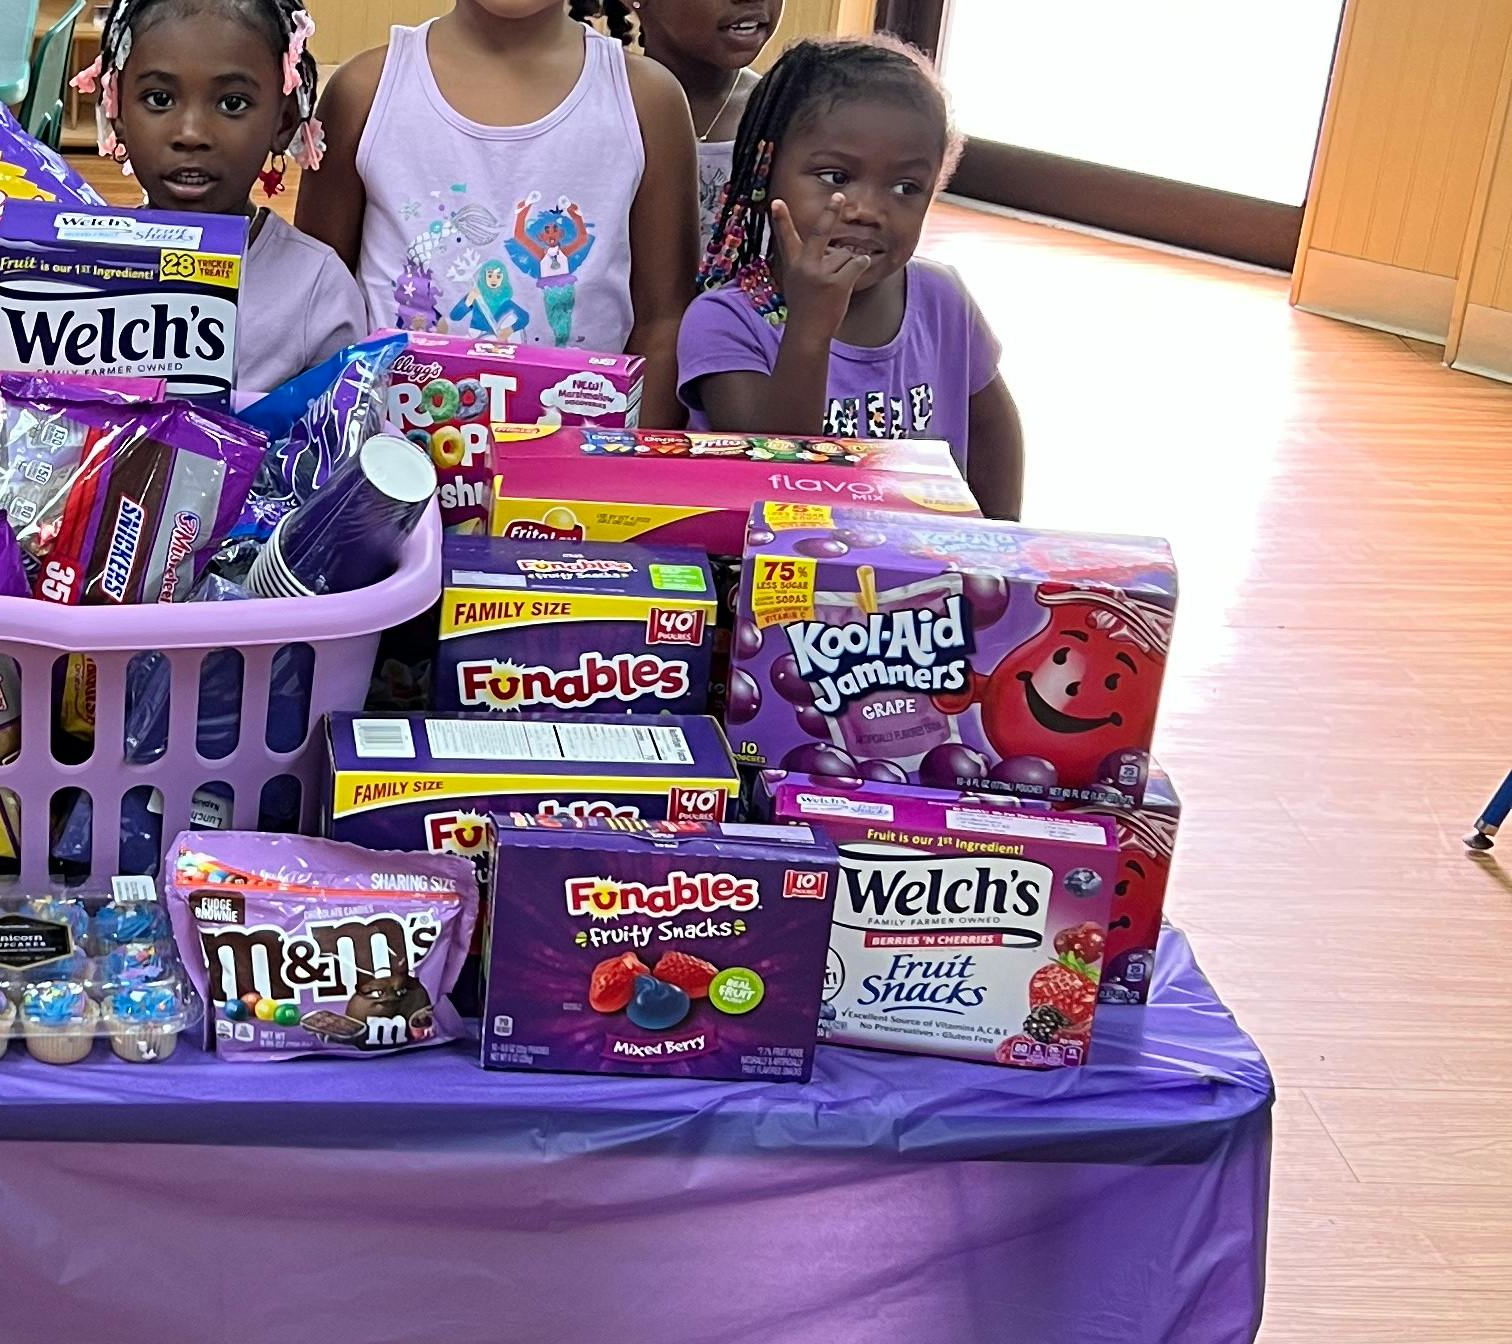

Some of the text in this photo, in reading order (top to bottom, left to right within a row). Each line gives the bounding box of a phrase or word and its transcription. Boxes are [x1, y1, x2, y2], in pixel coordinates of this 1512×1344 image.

[0, 256, 39, 271] Fruit
[40, 260, 50, 270] is
[52, 263, 72, 273] our
[93, 266, 154, 280] Ingredient!
[162, 254, 195, 277] 28
[0, 304, 225, 366] Welch's
[137, 362, 184, 373] OWNED
[388, 373, 518, 430] ROOT
[851, 492, 885, 503] MIX
[103, 500, 144, 599] SNICKERS
[520, 559, 638, 574] Funables
[764, 561, 808, 581] 75 %
[44, 561, 77, 604] 35
[453, 601, 572, 626] FAMILY SIZE
[660, 611, 693, 633] 40
[787, 595, 967, 677] Kool-Aid
[464, 657, 685, 703] Funables
[814, 657, 968, 713] Jammers
[862, 698, 916, 721] GRAPE
[740, 742, 759, 756] 10
[353, 780, 444, 804] FAMILY SIZE
[683, 791, 713, 813] 40
[867, 828, 1025, 856] Fruit is our 1st Ingredient!
[371, 872, 457, 892] SHARING SIZE
[795, 872, 813, 889] 10
[840, 866, 1040, 916] Welch's
[201, 897, 233, 911] FUDGE
[568, 872, 759, 919] Funables
[867, 916, 1001, 927] FAMILY FARMER OWNED
[588, 920, 734, 949] Fruity Snacks
[871, 936, 919, 946] BERRIES
[937, 934, 994, 945] CHERRIES
[885, 954, 976, 981] Fruit
[718, 985, 757, 1001] FRUIT
[857, 975, 988, 1006] Snacks
[890, 1014, 921, 1026] Source
[922, 1018, 933, 1027] of
[859, 1021, 873, 1031] No
[974, 1035, 994, 1045] Free
[613, 1034, 707, 1058] Mixed Berry
